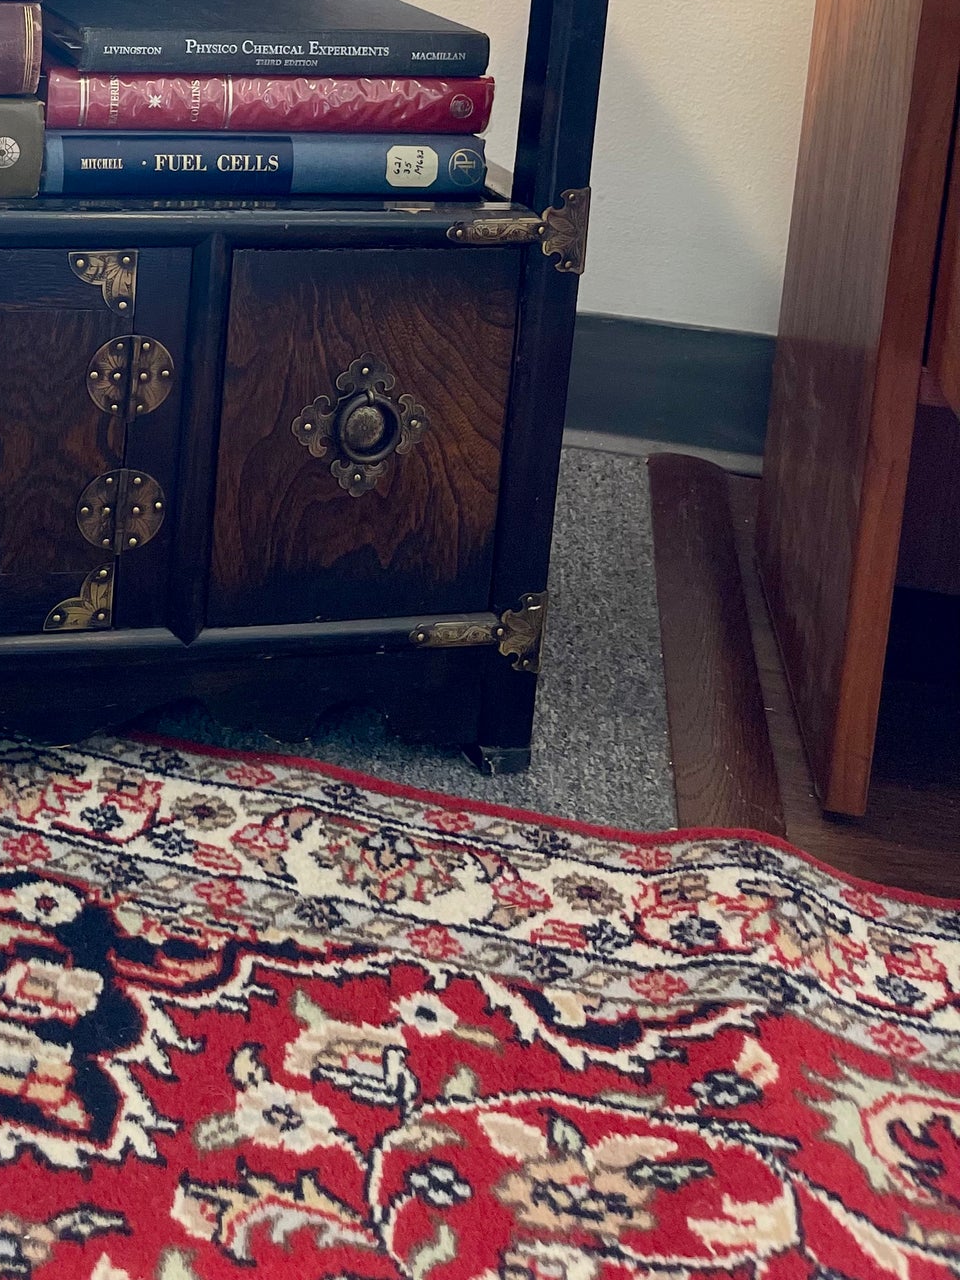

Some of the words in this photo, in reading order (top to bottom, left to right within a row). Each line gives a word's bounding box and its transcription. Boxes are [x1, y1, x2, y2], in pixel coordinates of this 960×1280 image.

[103, 46, 162, 55] LIVINGSTON
[411, 51, 466, 61] MACMILLAN
[256, 58, 282, 66] THIRD
[283, 58, 318, 67] EDITION
[191, 79, 201, 122] COLLINS
[81, 158, 123, 170] MITCHELL
[154, 154, 208, 171] FUEL
[216, 154, 280, 172] CELLS
